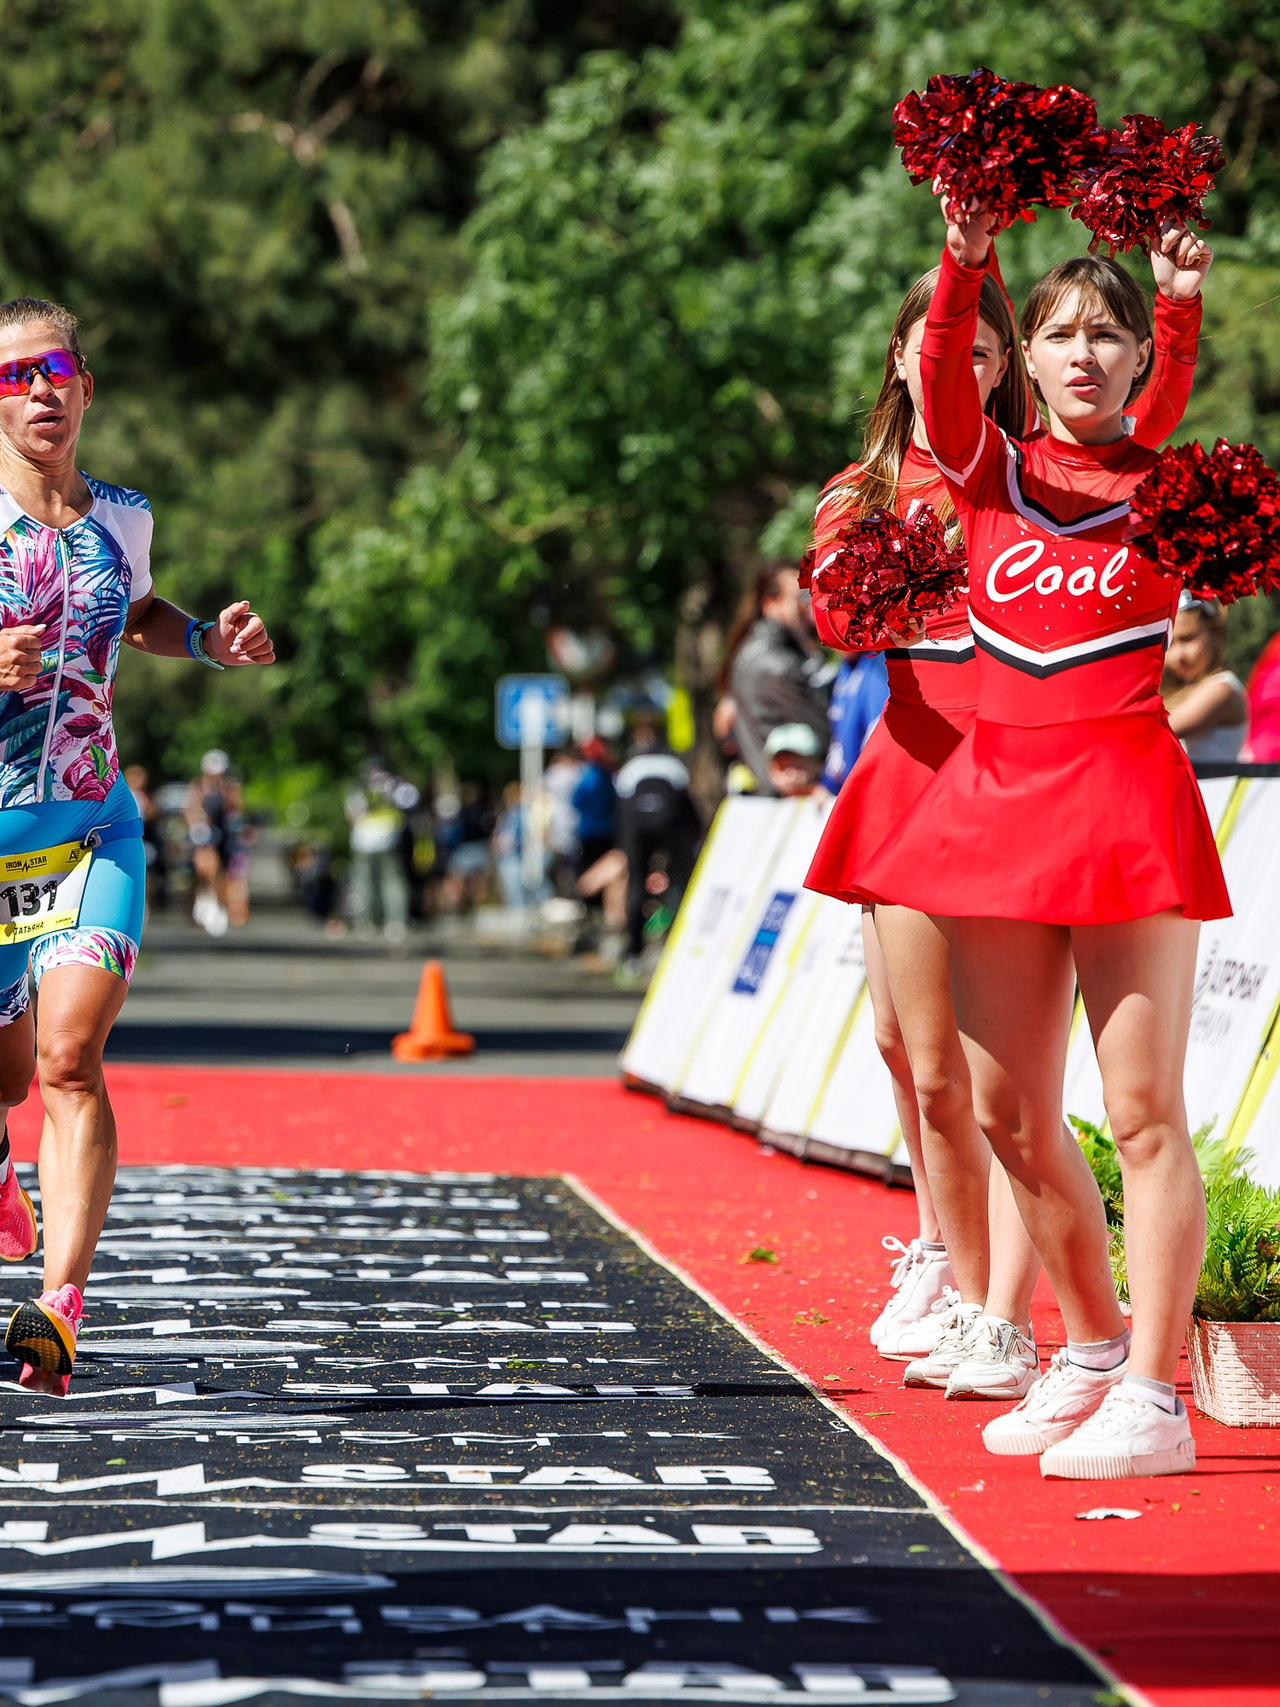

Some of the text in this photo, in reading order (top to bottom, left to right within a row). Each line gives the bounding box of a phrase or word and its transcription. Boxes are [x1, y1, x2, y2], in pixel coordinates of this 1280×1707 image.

[985, 539, 1128, 603] Cool
[5, 856, 47, 870] IRON STAR
[281, 1383, 695, 1396] STAR
[299, 1464, 774, 1485] STAR
[308, 1523, 820, 1546] STAR
[343, 1660, 952, 1692] STAR
